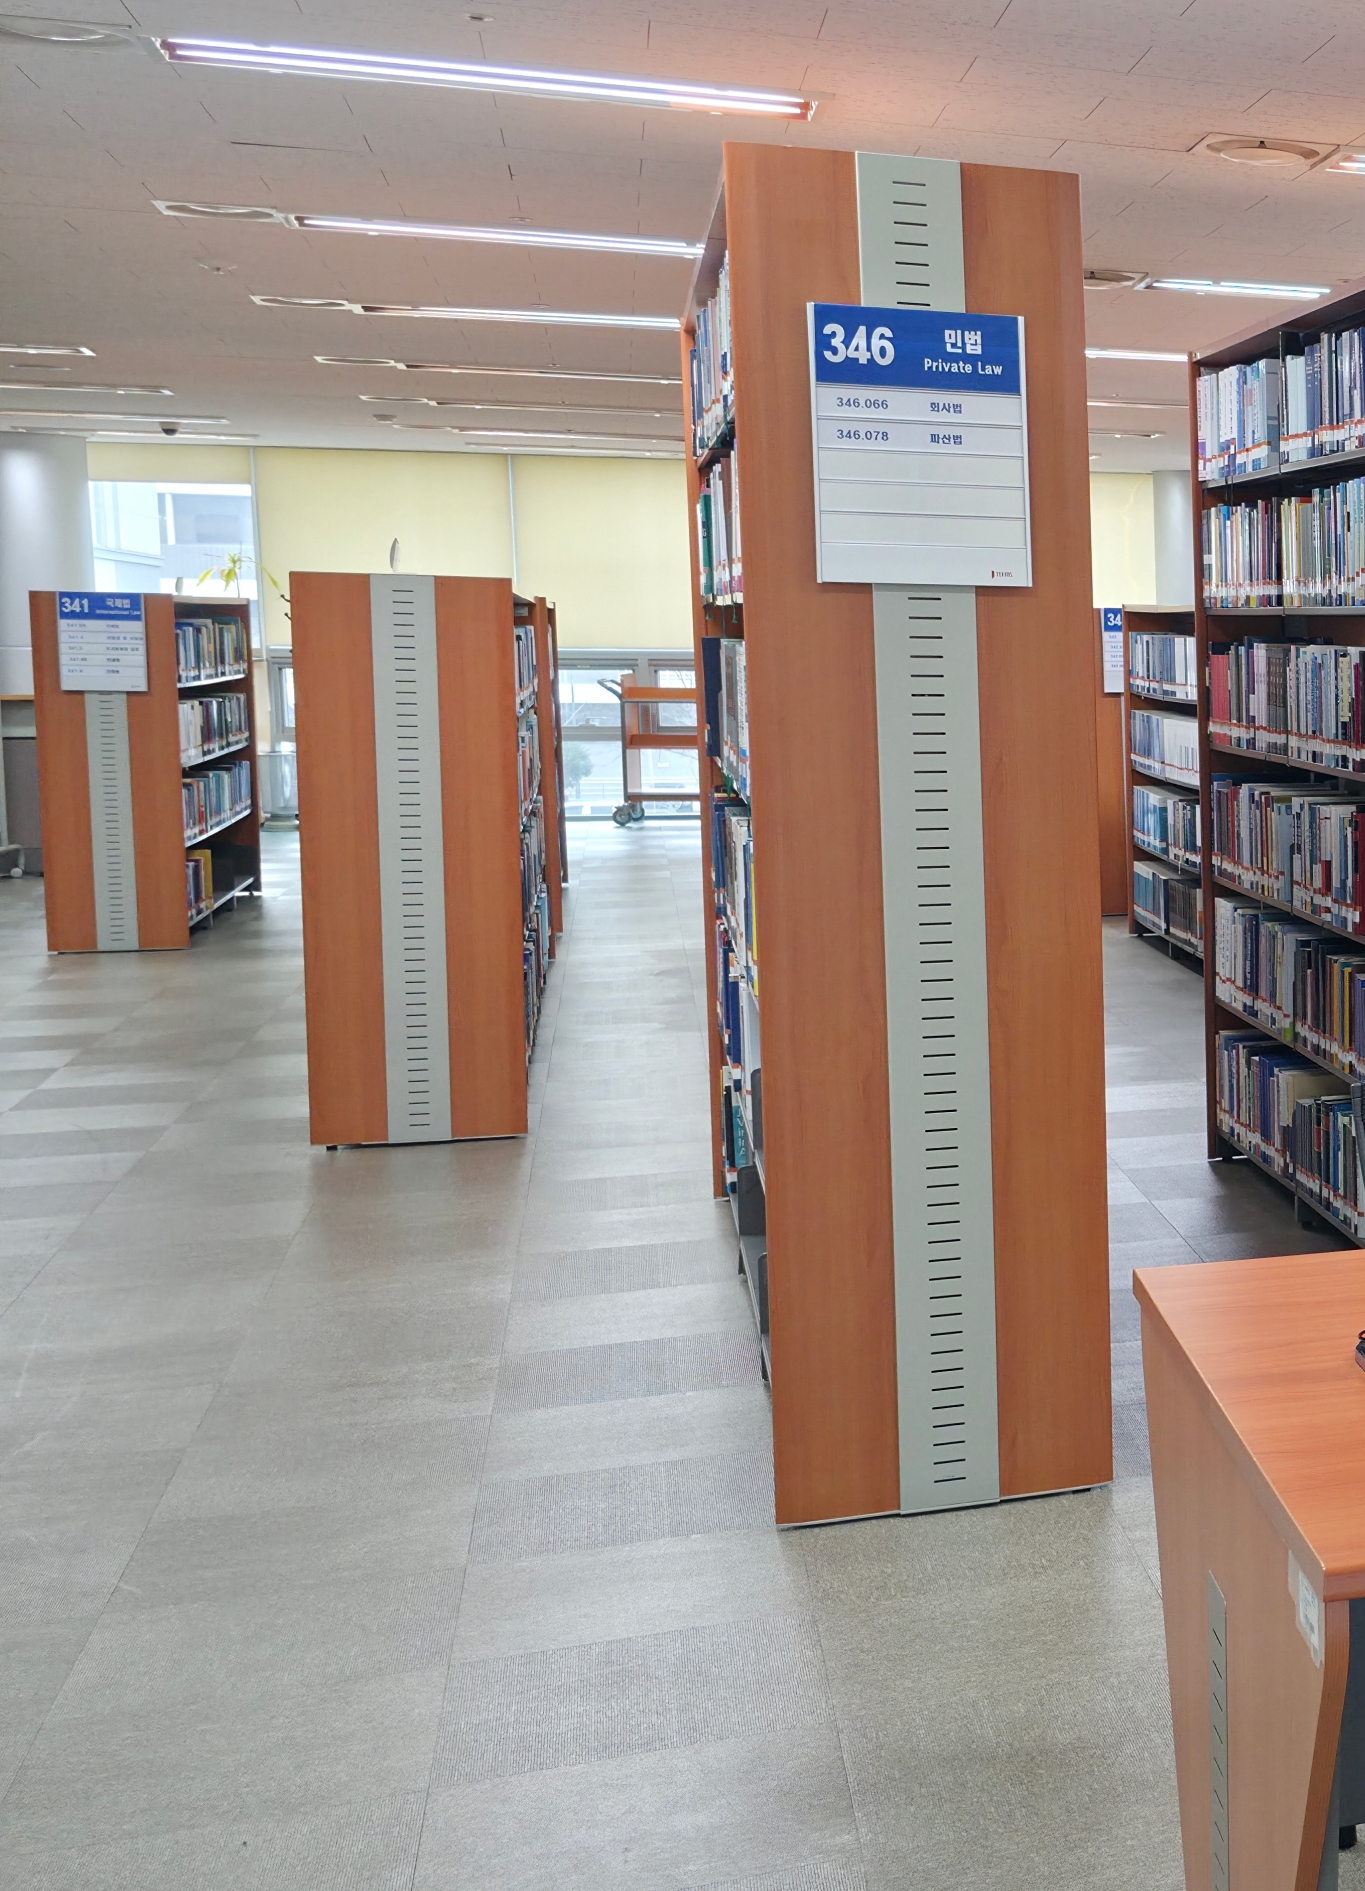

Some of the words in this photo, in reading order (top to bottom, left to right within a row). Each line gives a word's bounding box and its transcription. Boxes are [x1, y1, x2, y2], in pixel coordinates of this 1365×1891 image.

[822, 323, 895, 366] 346
[944, 329, 982, 355] 민법
[924, 358, 973, 375] Private
[978, 362, 1003, 376] Law
[836, 397, 889, 410] 346.066
[929, 402, 963, 414] 회사법
[836, 429, 889, 442] 346.078
[929, 433, 963, 445] 파산법
[61, 597, 89, 613] 341
